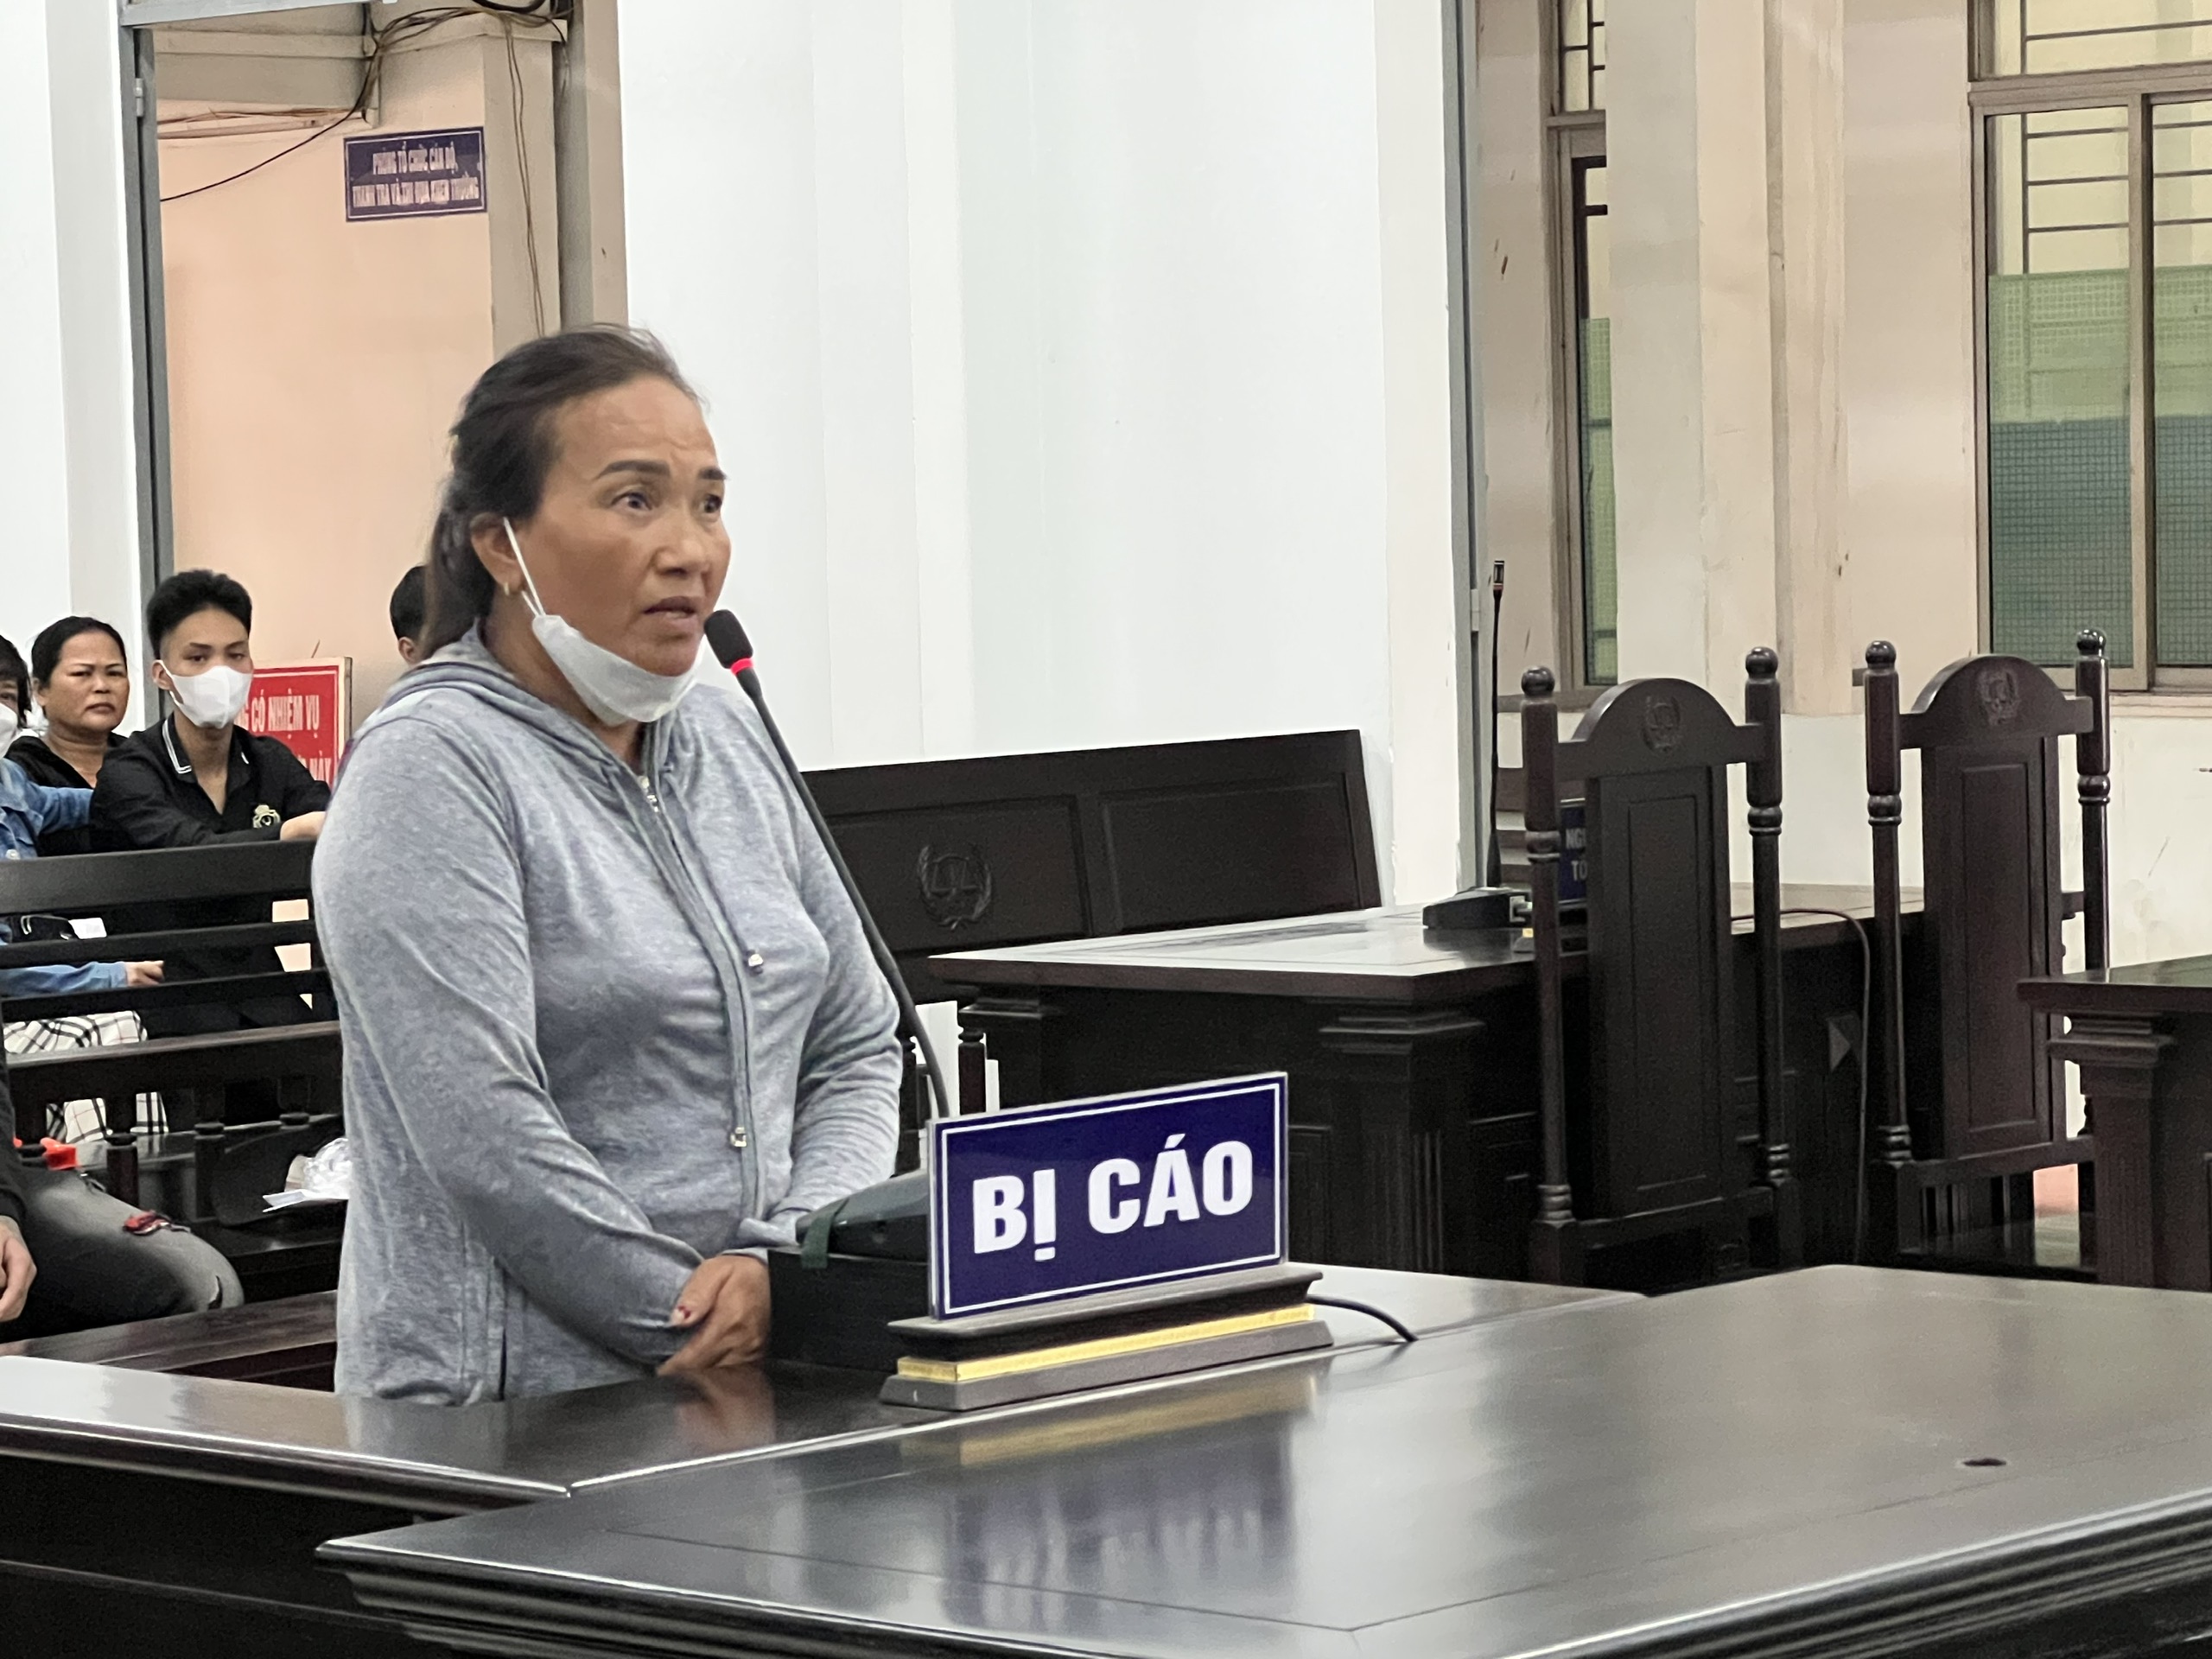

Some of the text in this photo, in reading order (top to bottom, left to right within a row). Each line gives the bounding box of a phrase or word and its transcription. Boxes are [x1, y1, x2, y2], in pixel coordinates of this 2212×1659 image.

[251, 689, 266, 733] CÓ
[268, 688, 304, 740] NHIỆM
[305, 694, 320, 739] VỤ
[972, 1133, 1253, 1262] BỊ CÁO
